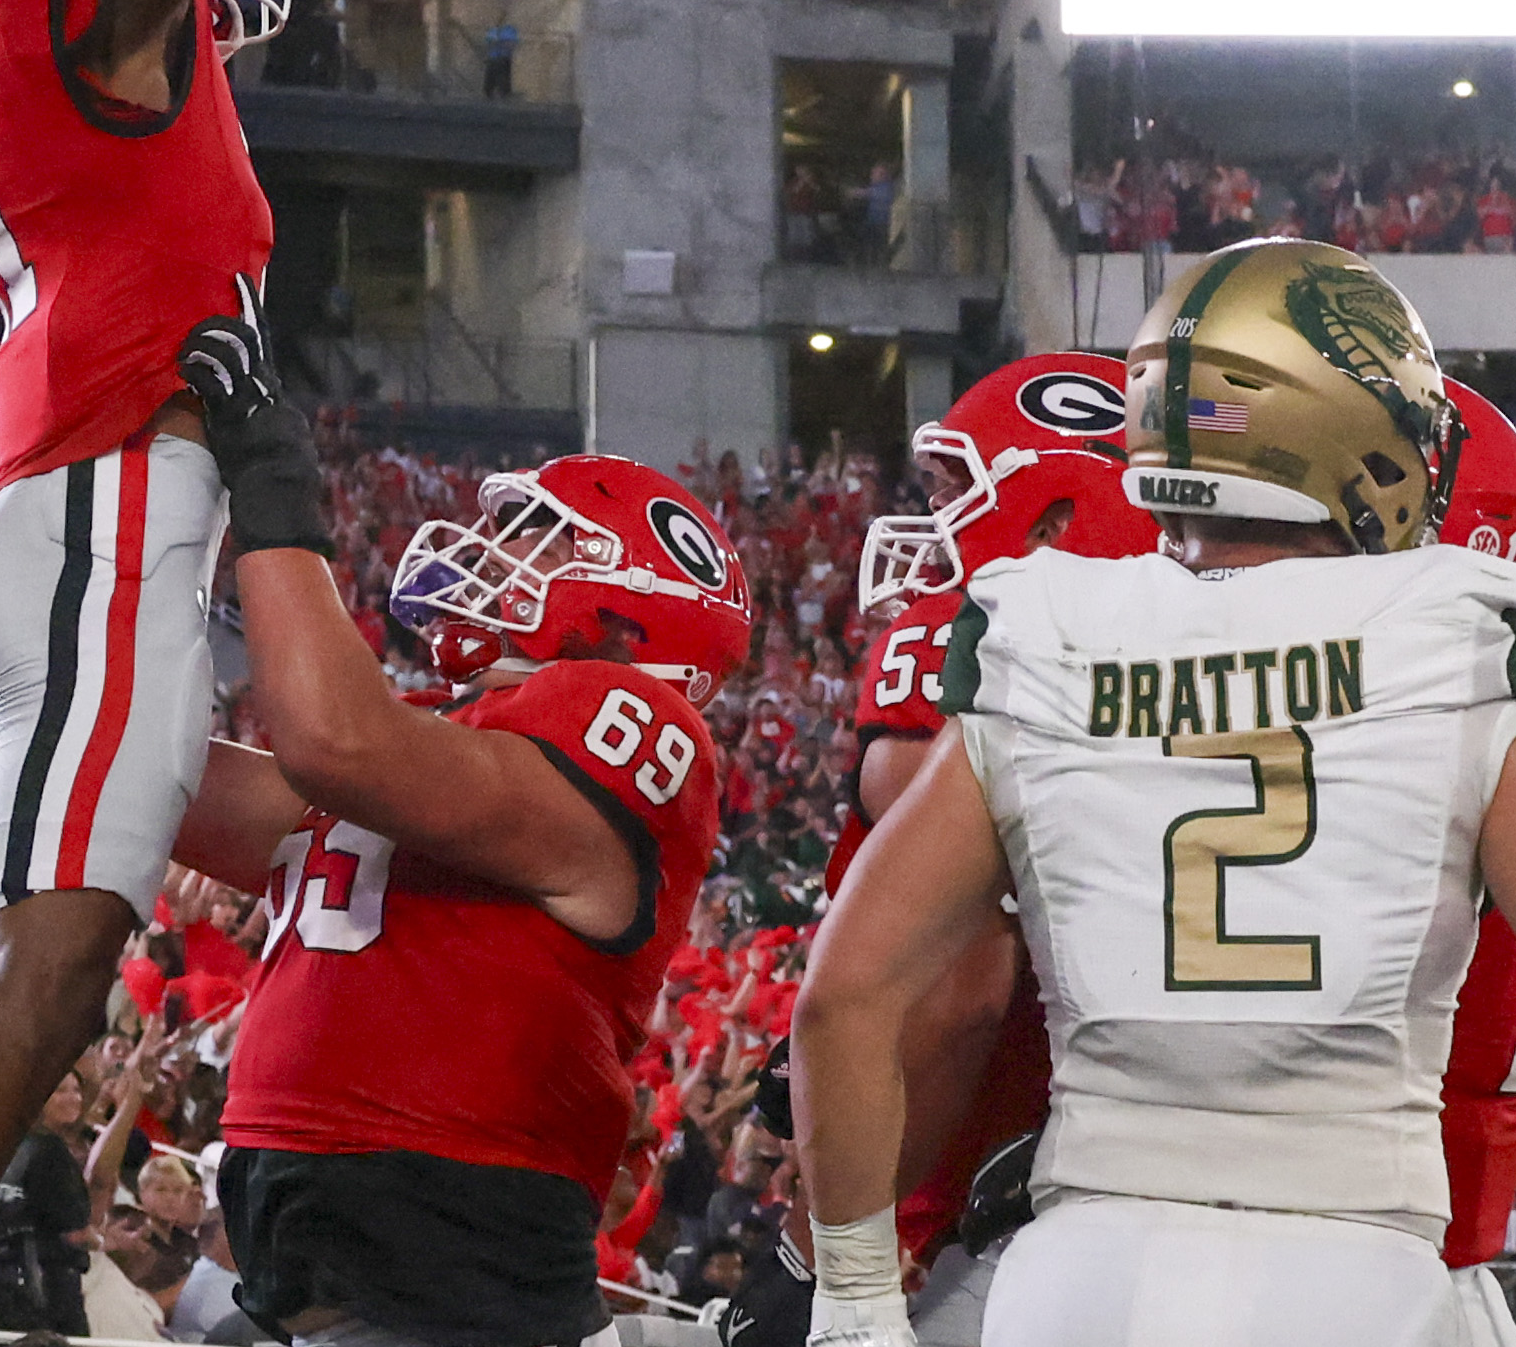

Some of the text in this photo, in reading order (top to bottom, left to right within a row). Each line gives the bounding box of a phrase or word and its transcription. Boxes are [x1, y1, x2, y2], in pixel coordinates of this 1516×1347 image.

[1170, 317, 1198, 339] 205
[1138, 475, 1221, 509] BLAZERS
[1088, 636, 1366, 738] BRATTON
[583, 688, 696, 806] 69
[1162, 724, 1323, 992] 2
